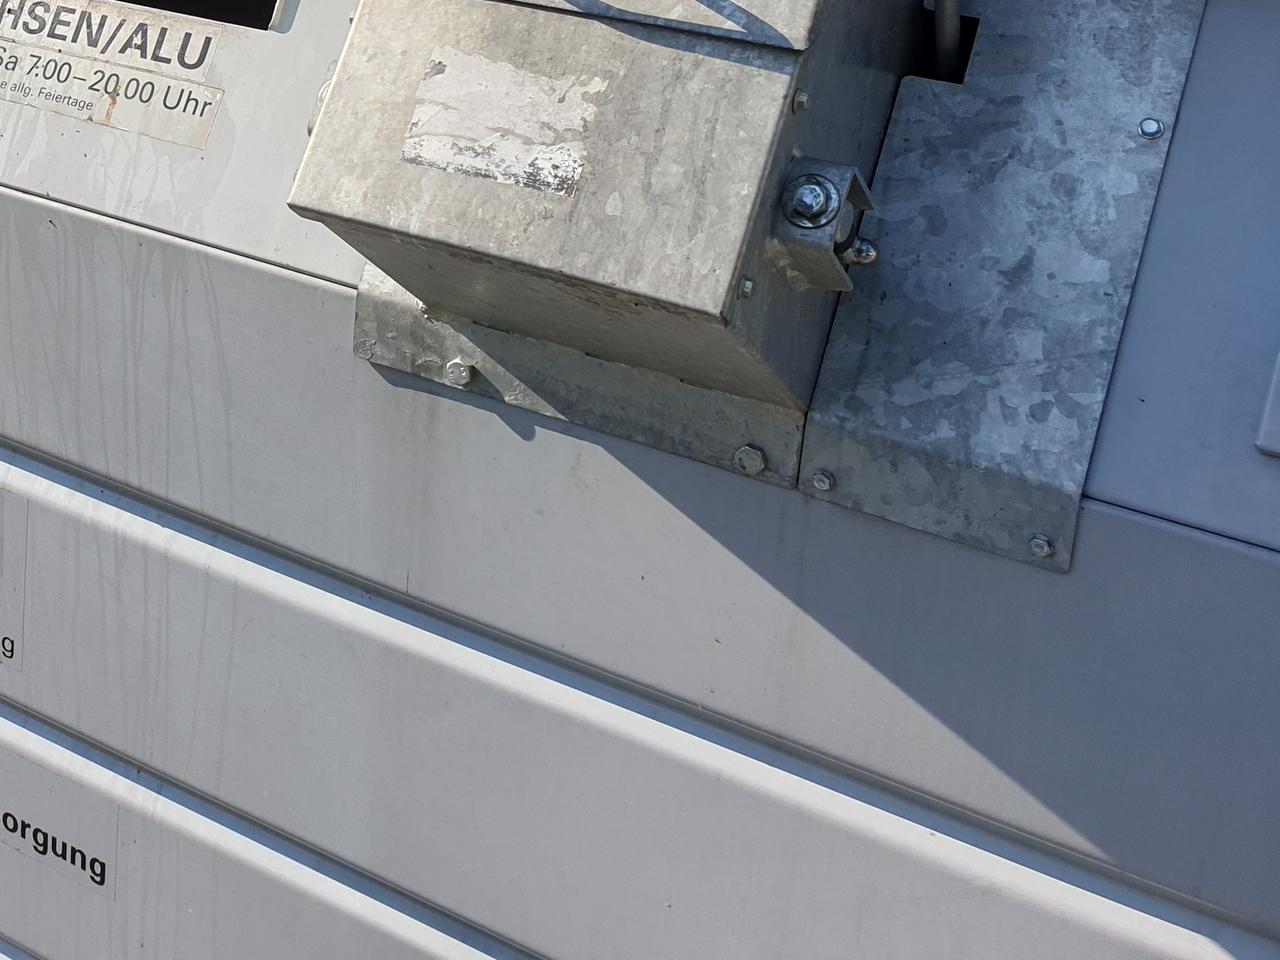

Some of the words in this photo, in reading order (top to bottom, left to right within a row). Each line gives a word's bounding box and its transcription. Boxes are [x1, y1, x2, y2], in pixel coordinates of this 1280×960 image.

[10, 80, 34, 99] allg.
[37, 86, 94, 112] Feiertage
[162, 84, 213, 119] Uhr
